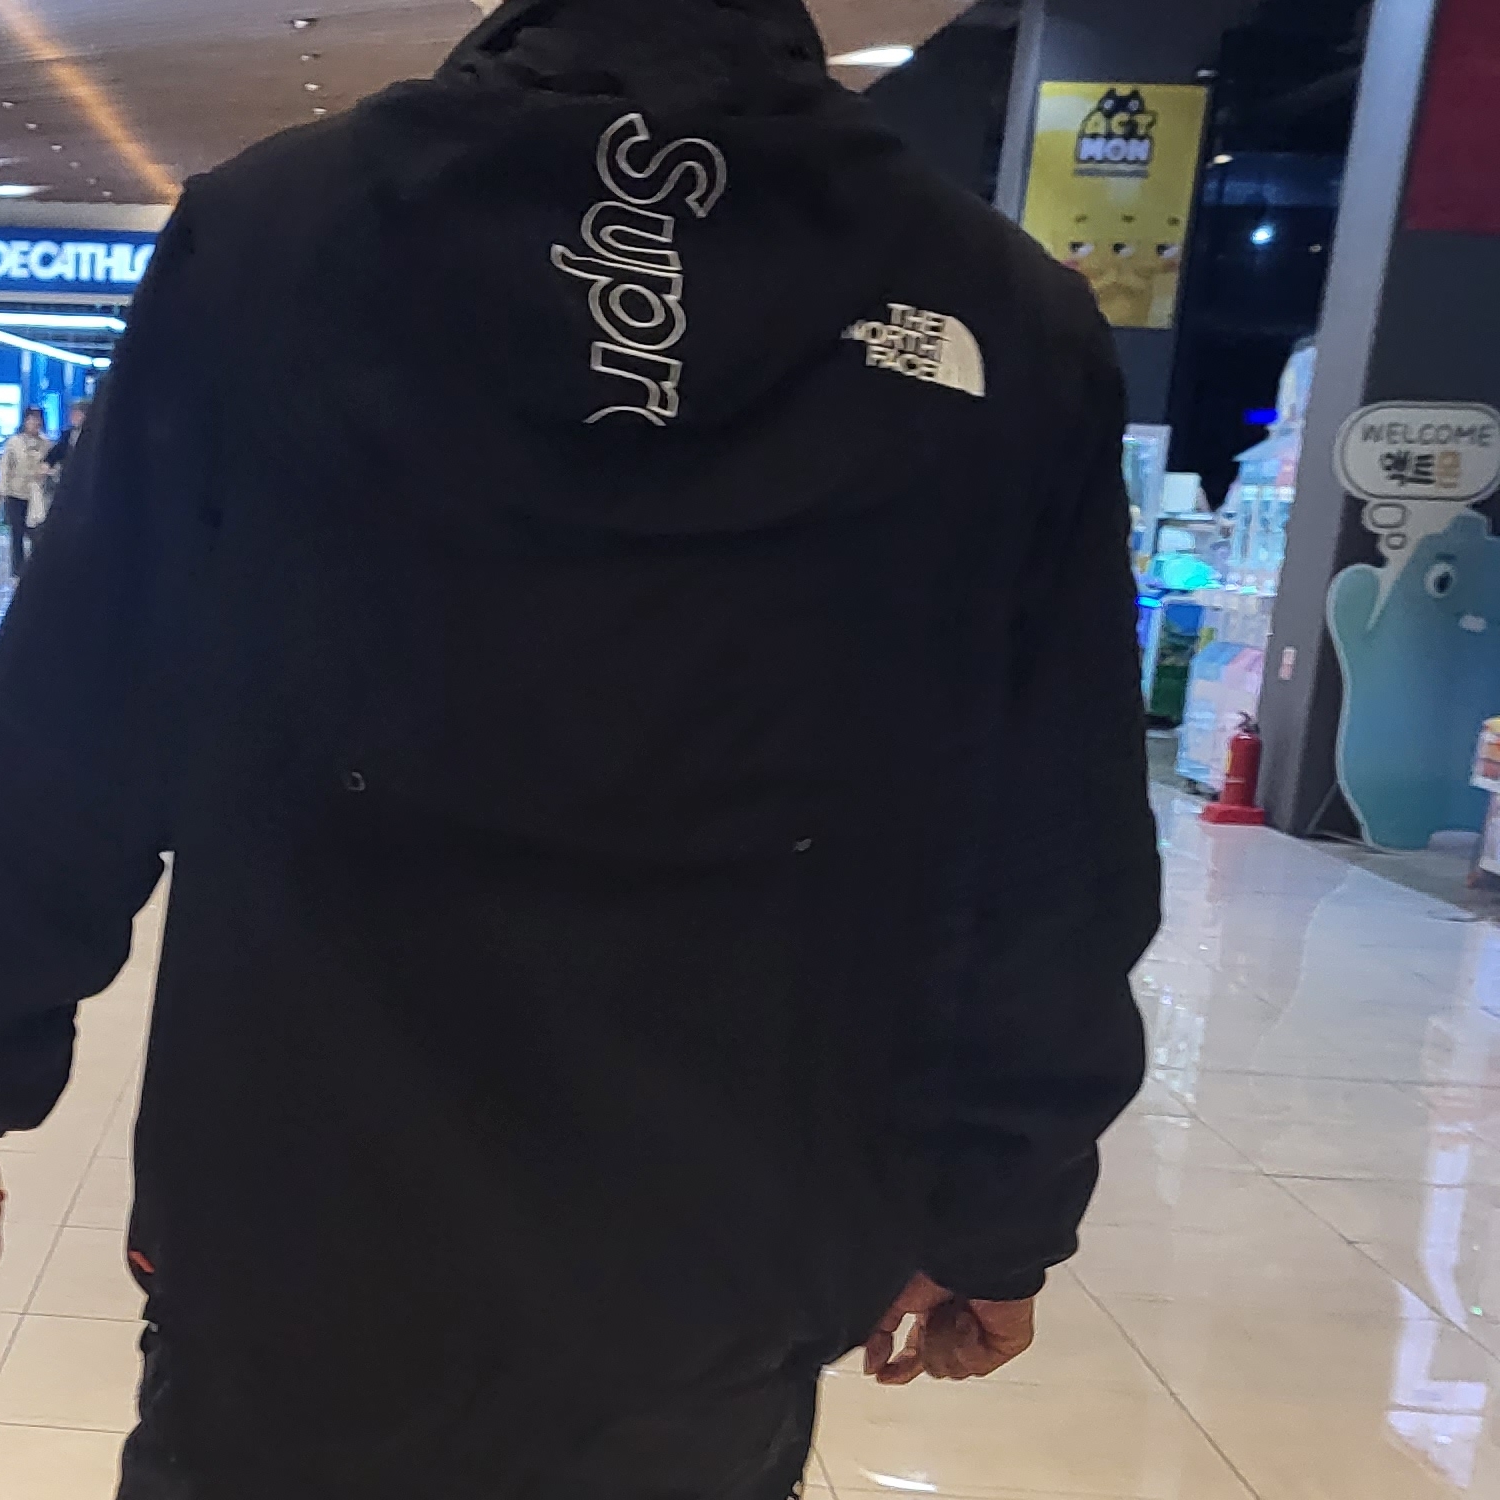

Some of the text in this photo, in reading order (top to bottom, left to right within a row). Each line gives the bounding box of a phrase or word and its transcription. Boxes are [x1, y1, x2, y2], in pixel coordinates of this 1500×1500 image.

[1084, 110, 1156, 135] ACT
[551, 112, 728, 425] Supr
[887, 302, 946, 336] THE
[865, 344, 937, 382] FACE
[1362, 421, 1493, 447] WELCOME
